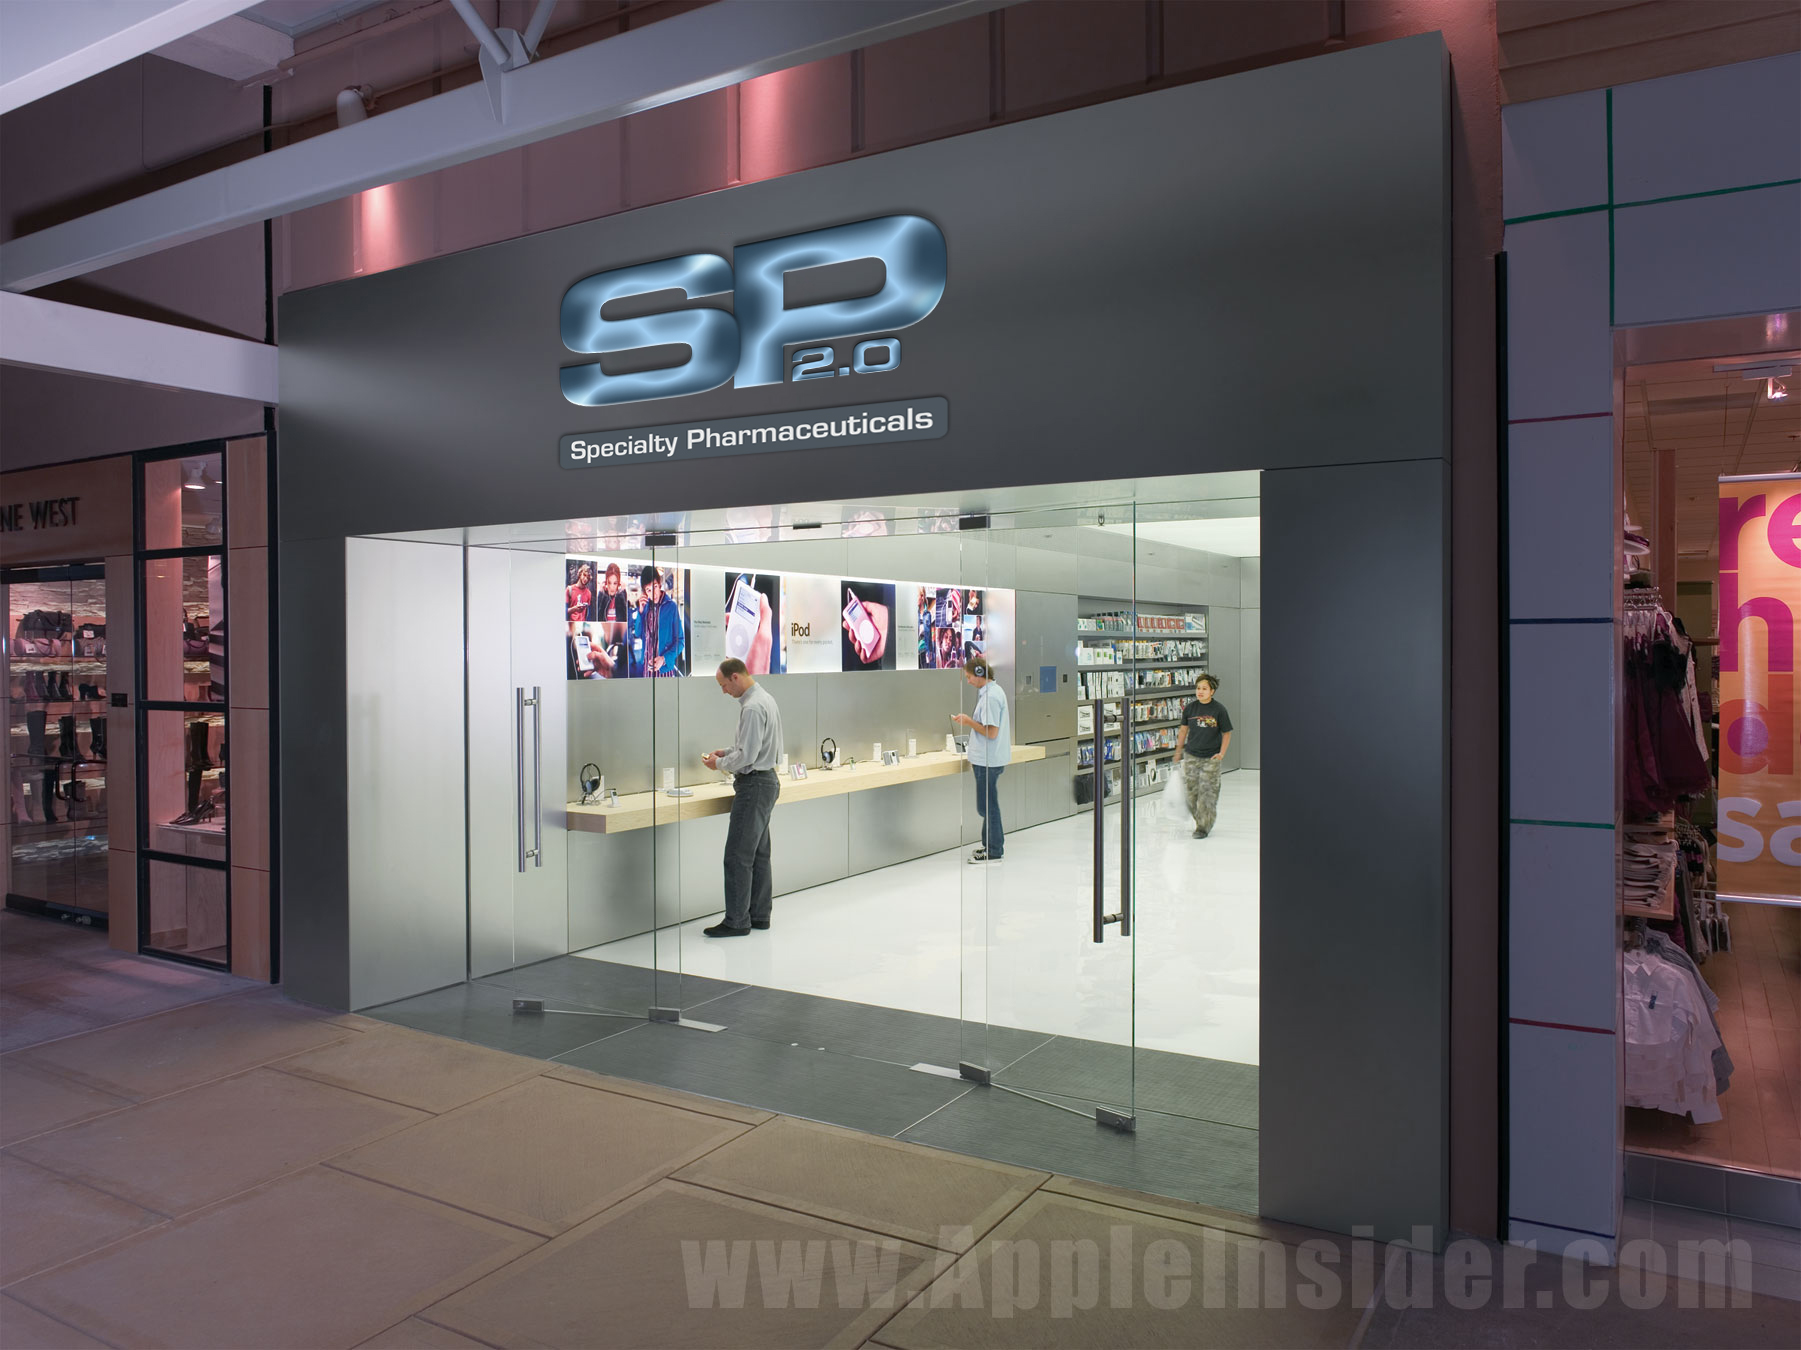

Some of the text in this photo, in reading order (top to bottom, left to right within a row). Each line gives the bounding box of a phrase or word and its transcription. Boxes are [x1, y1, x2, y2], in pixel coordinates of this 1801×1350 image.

[560, 214, 947, 407] SP
[792, 337, 902, 382] 2.0
[570, 407, 934, 463] Specialty Pharmaceuticals
[29, 496, 81, 530] WEST
[791, 622, 811, 637] iPod
